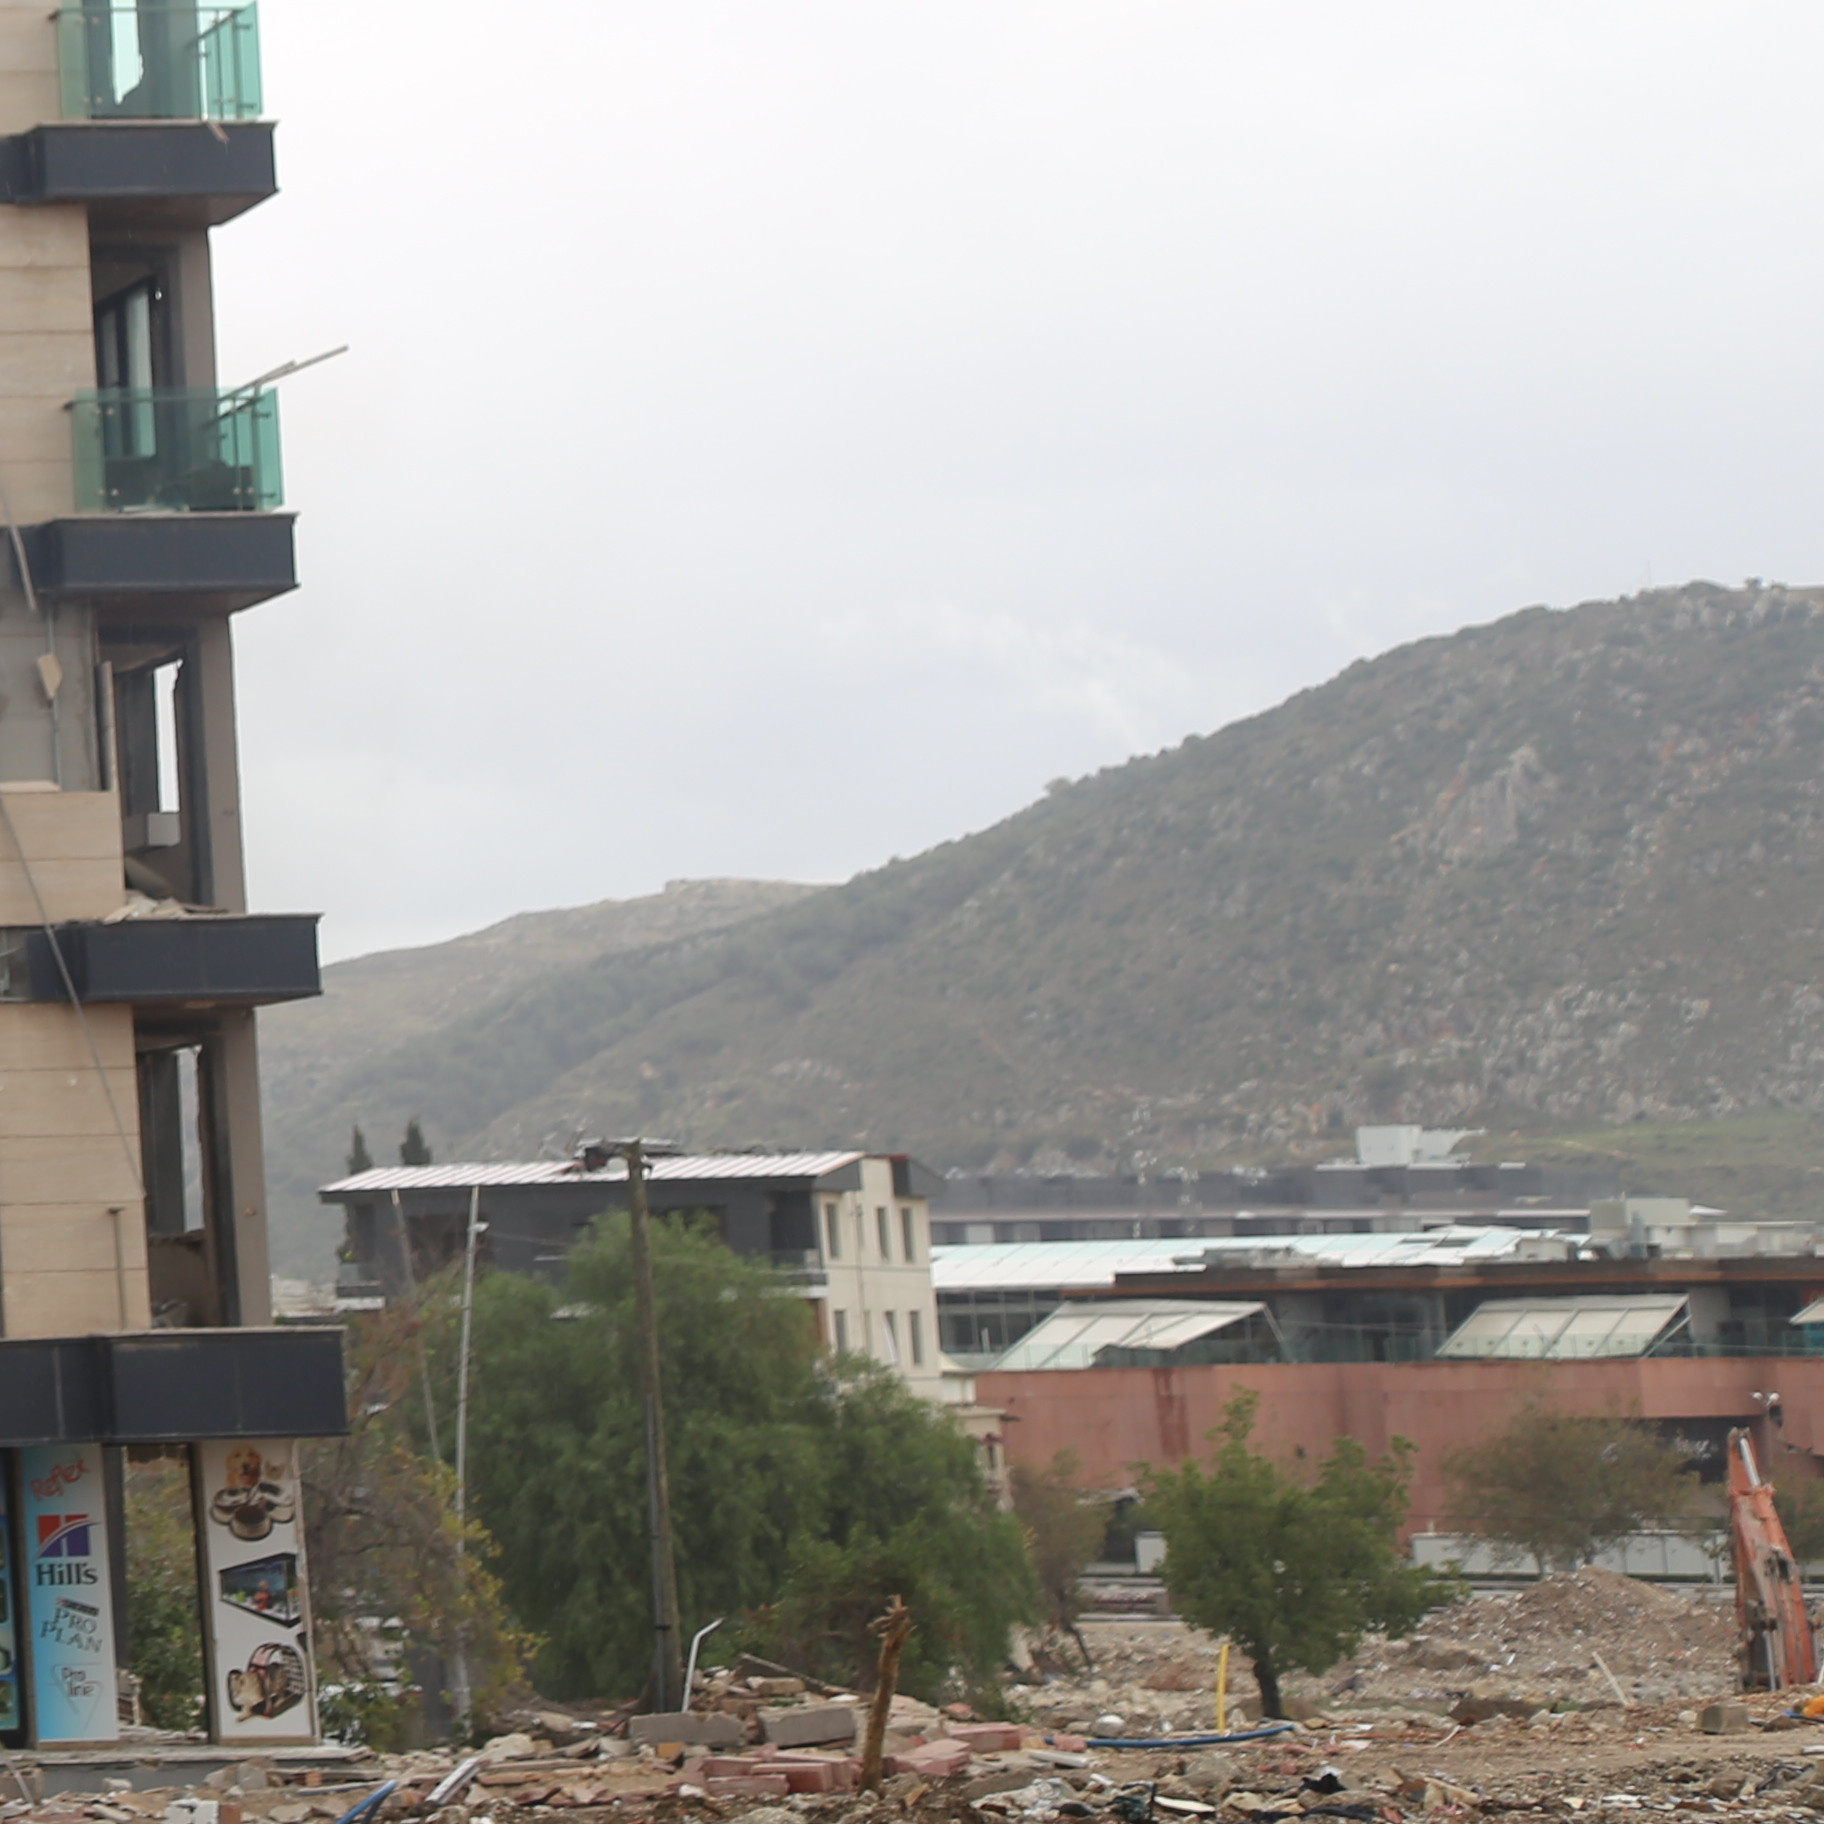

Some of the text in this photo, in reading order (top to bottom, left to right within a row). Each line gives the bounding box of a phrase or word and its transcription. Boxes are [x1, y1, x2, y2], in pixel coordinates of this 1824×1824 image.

[35, 1562, 99, 1586] Hill's
[53, 1607, 98, 1635] PRO
[39, 1620, 104, 1653] PLAN
